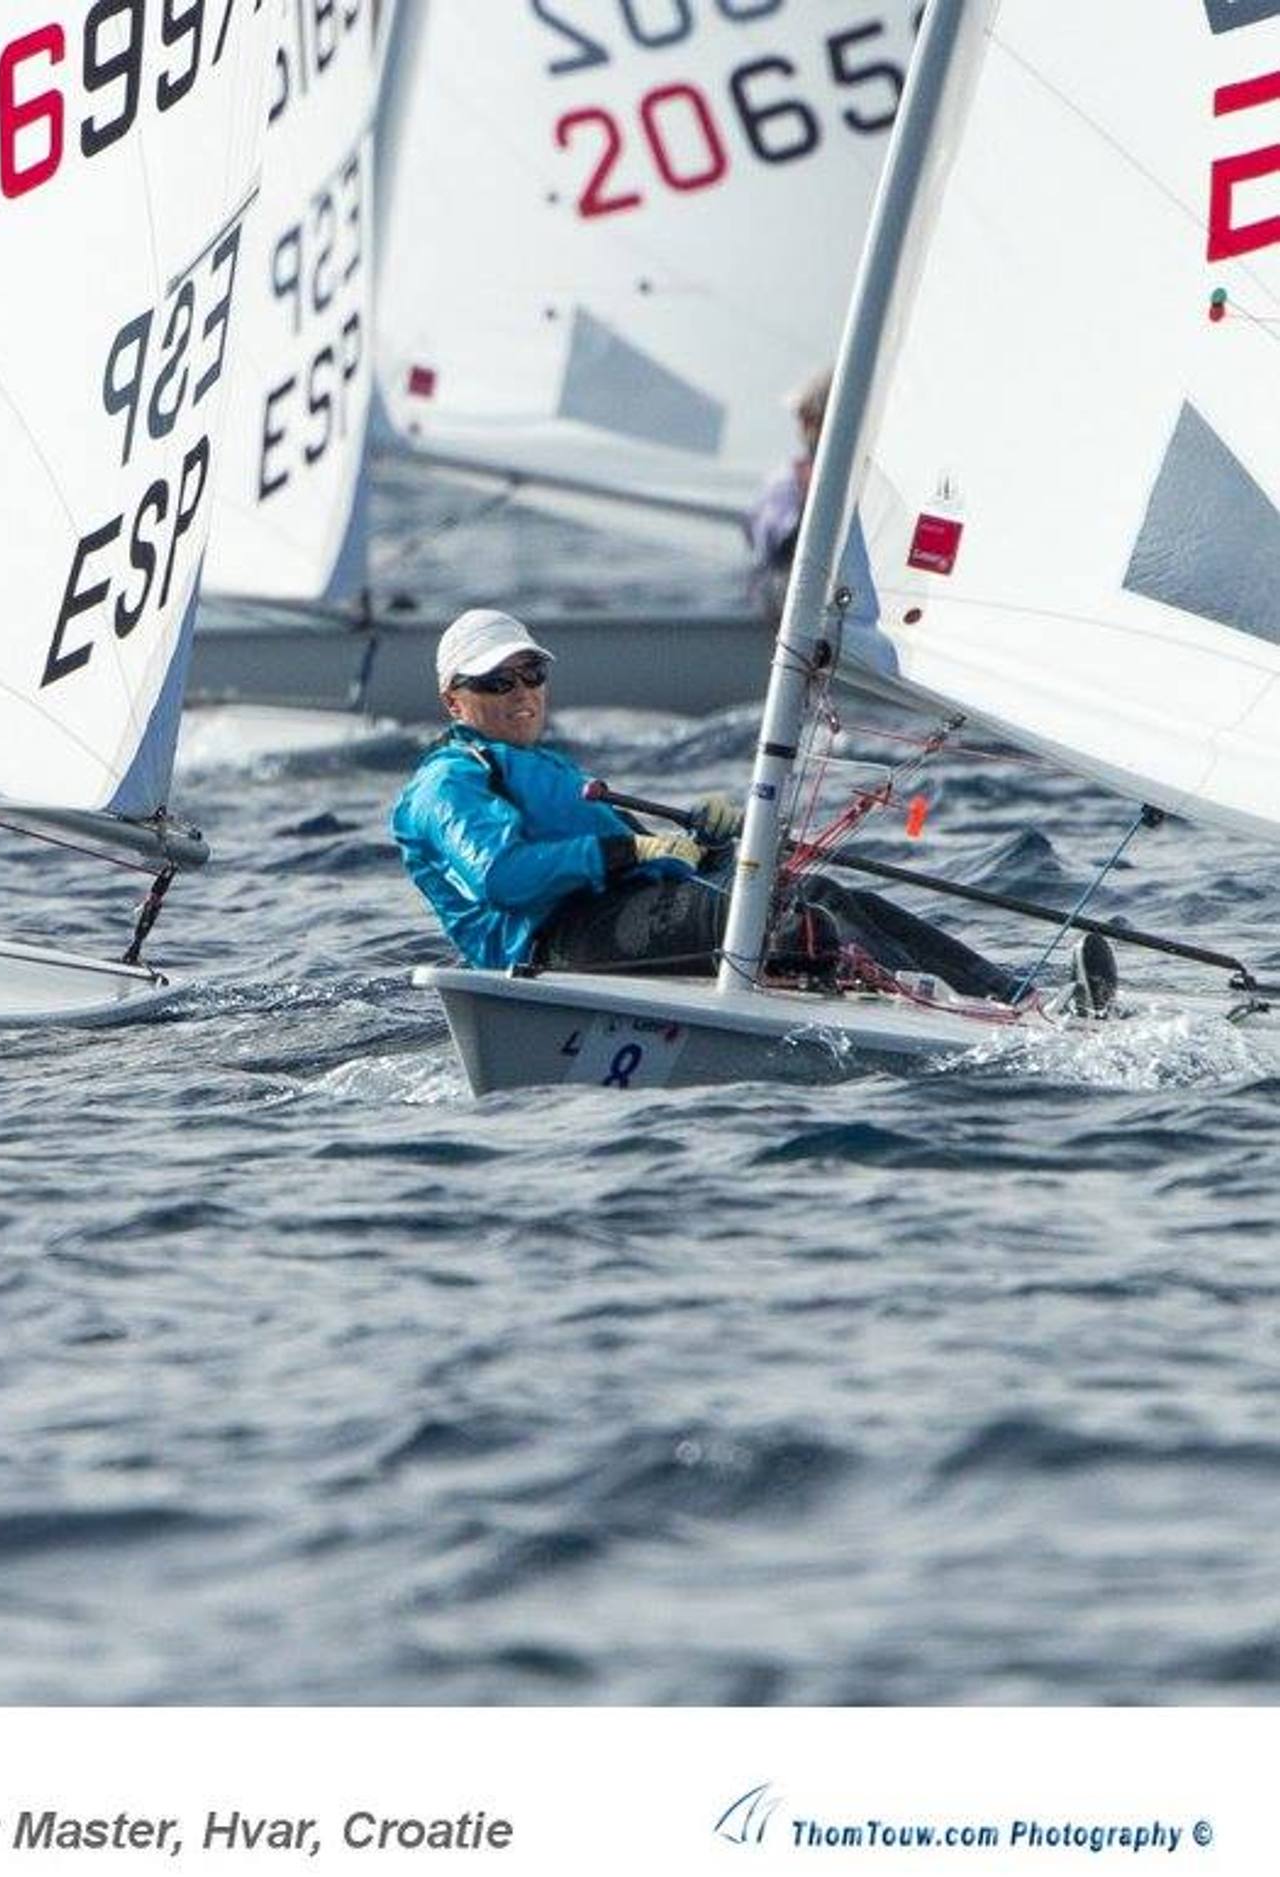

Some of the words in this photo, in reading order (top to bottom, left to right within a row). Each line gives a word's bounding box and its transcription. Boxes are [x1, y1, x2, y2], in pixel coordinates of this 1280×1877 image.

[556, 10, 925, 218] 2065
[258, 312, 361, 500] ESP
[39, 434, 209, 689] ESP
